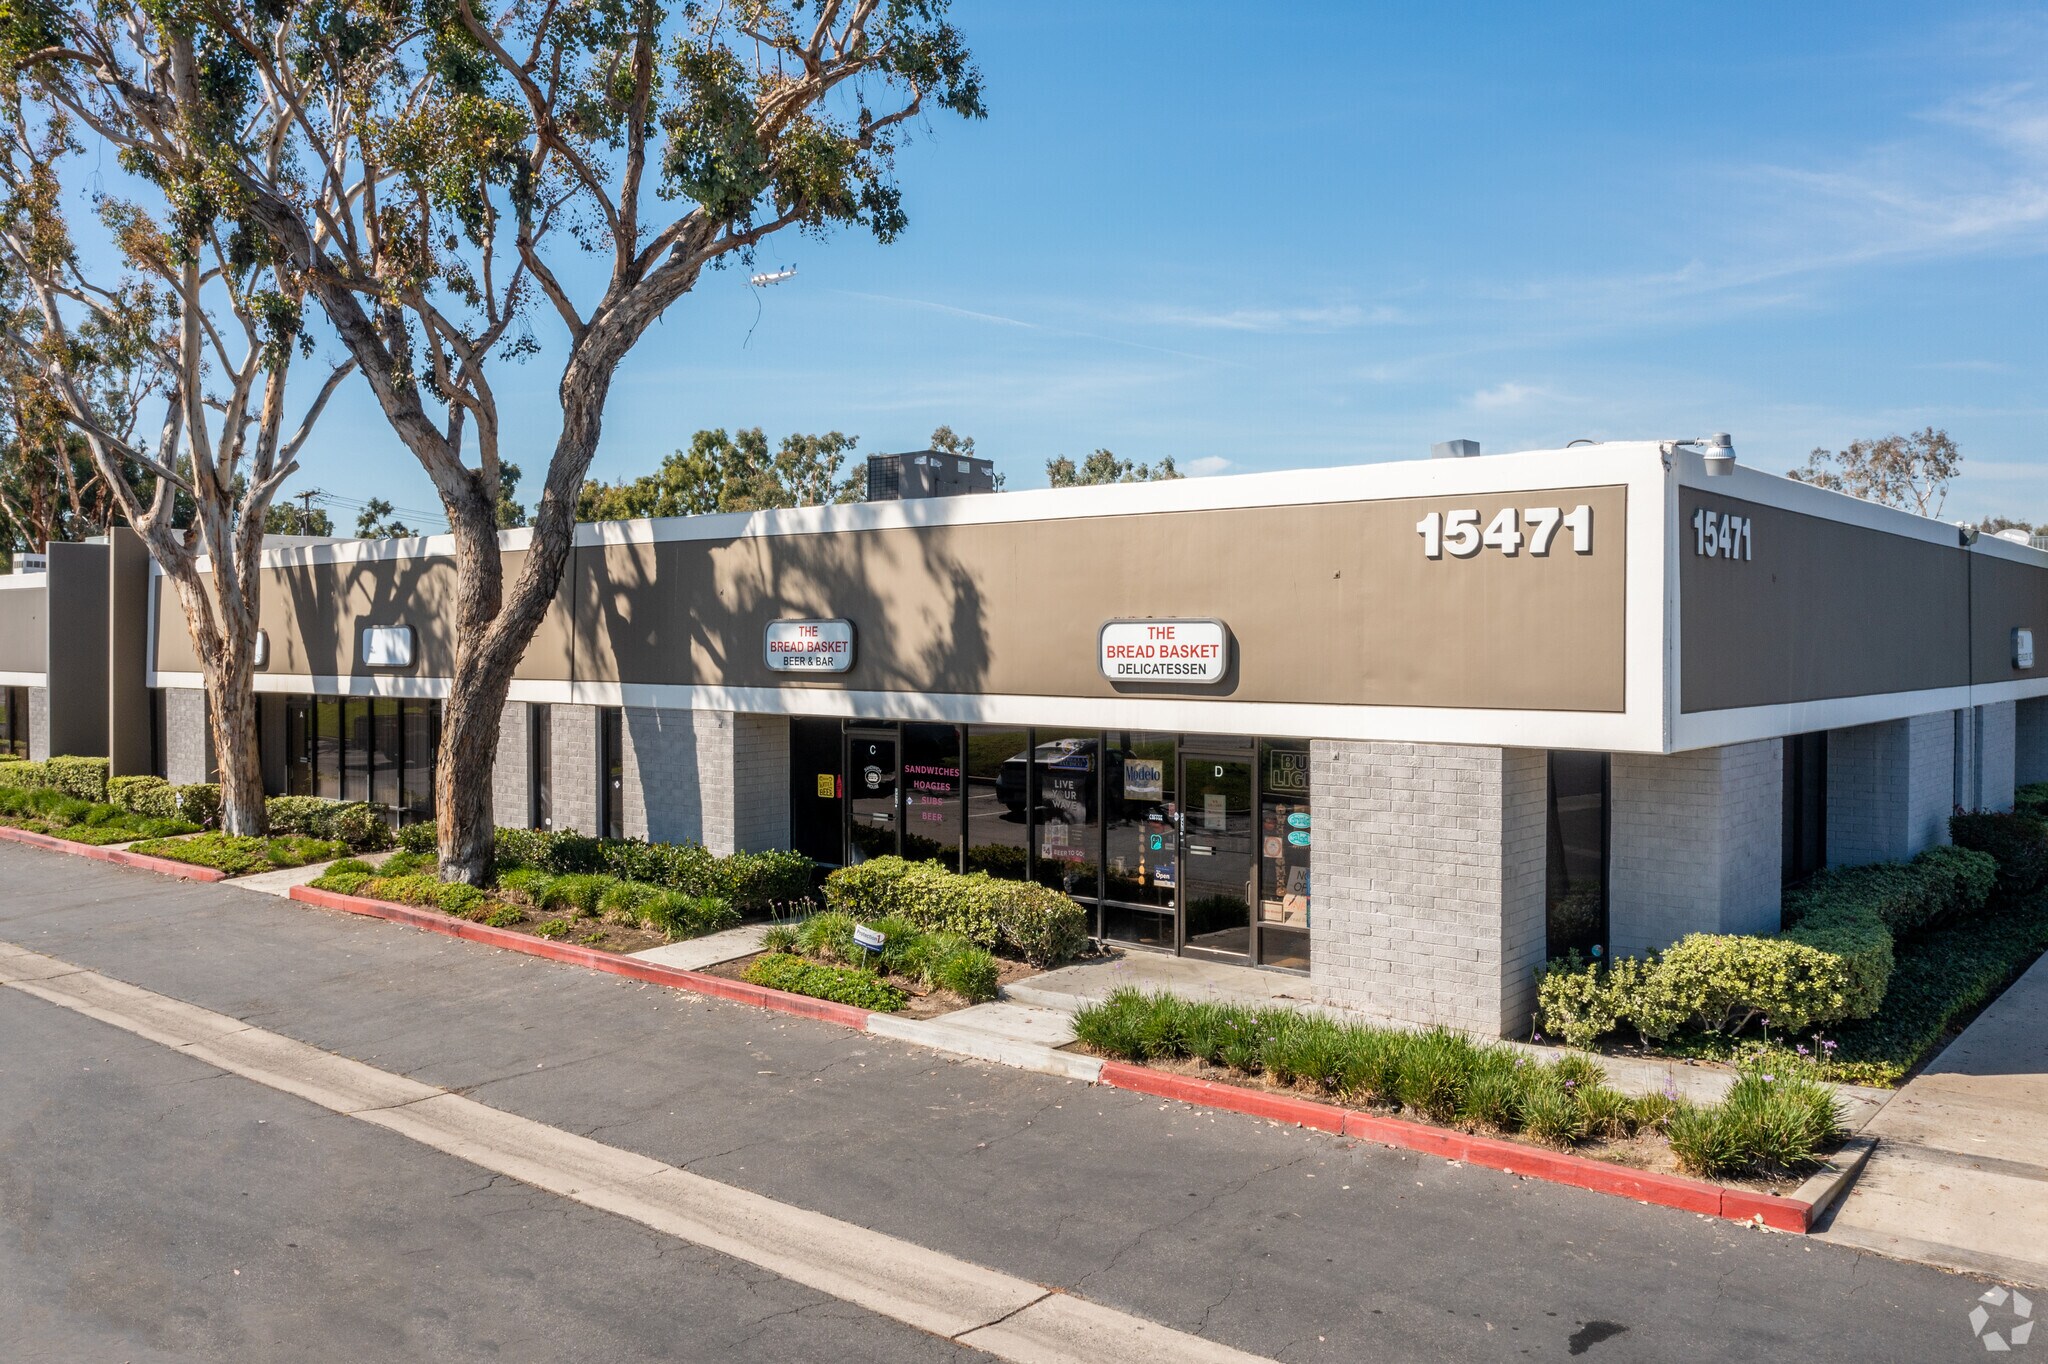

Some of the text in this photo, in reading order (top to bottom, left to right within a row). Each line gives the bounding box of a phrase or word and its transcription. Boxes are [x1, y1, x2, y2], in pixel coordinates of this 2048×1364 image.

[1416, 505, 1592, 557] 15471
[1694, 509, 1752, 561] 15471
[799, 626, 818, 637] THE
[1147, 626, 1176, 640] THE
[770, 641, 848, 653] BREAD BASKET
[1106, 644, 1219, 659] BREAD BASKET
[783, 656, 834, 666] BEER & BAR
[1117, 663, 1207, 675] DELICATESSEN
[869, 744, 877, 755] C
[1281, 753, 1310, 772] BU
[904, 764, 960, 777] SANDWICHES
[1126, 764, 1161, 782] Modelo
[1214, 765, 1224, 778] D
[1272, 769, 1310, 788] LIG
[913, 780, 951, 791] HOAGIES
[1054, 780, 1074, 790] LIVE
[921, 796, 943, 806] SUBS
[1052, 800, 1077, 811] WAVE
[921, 811, 943, 821] BEER
[1155, 872, 1171, 880] Open
